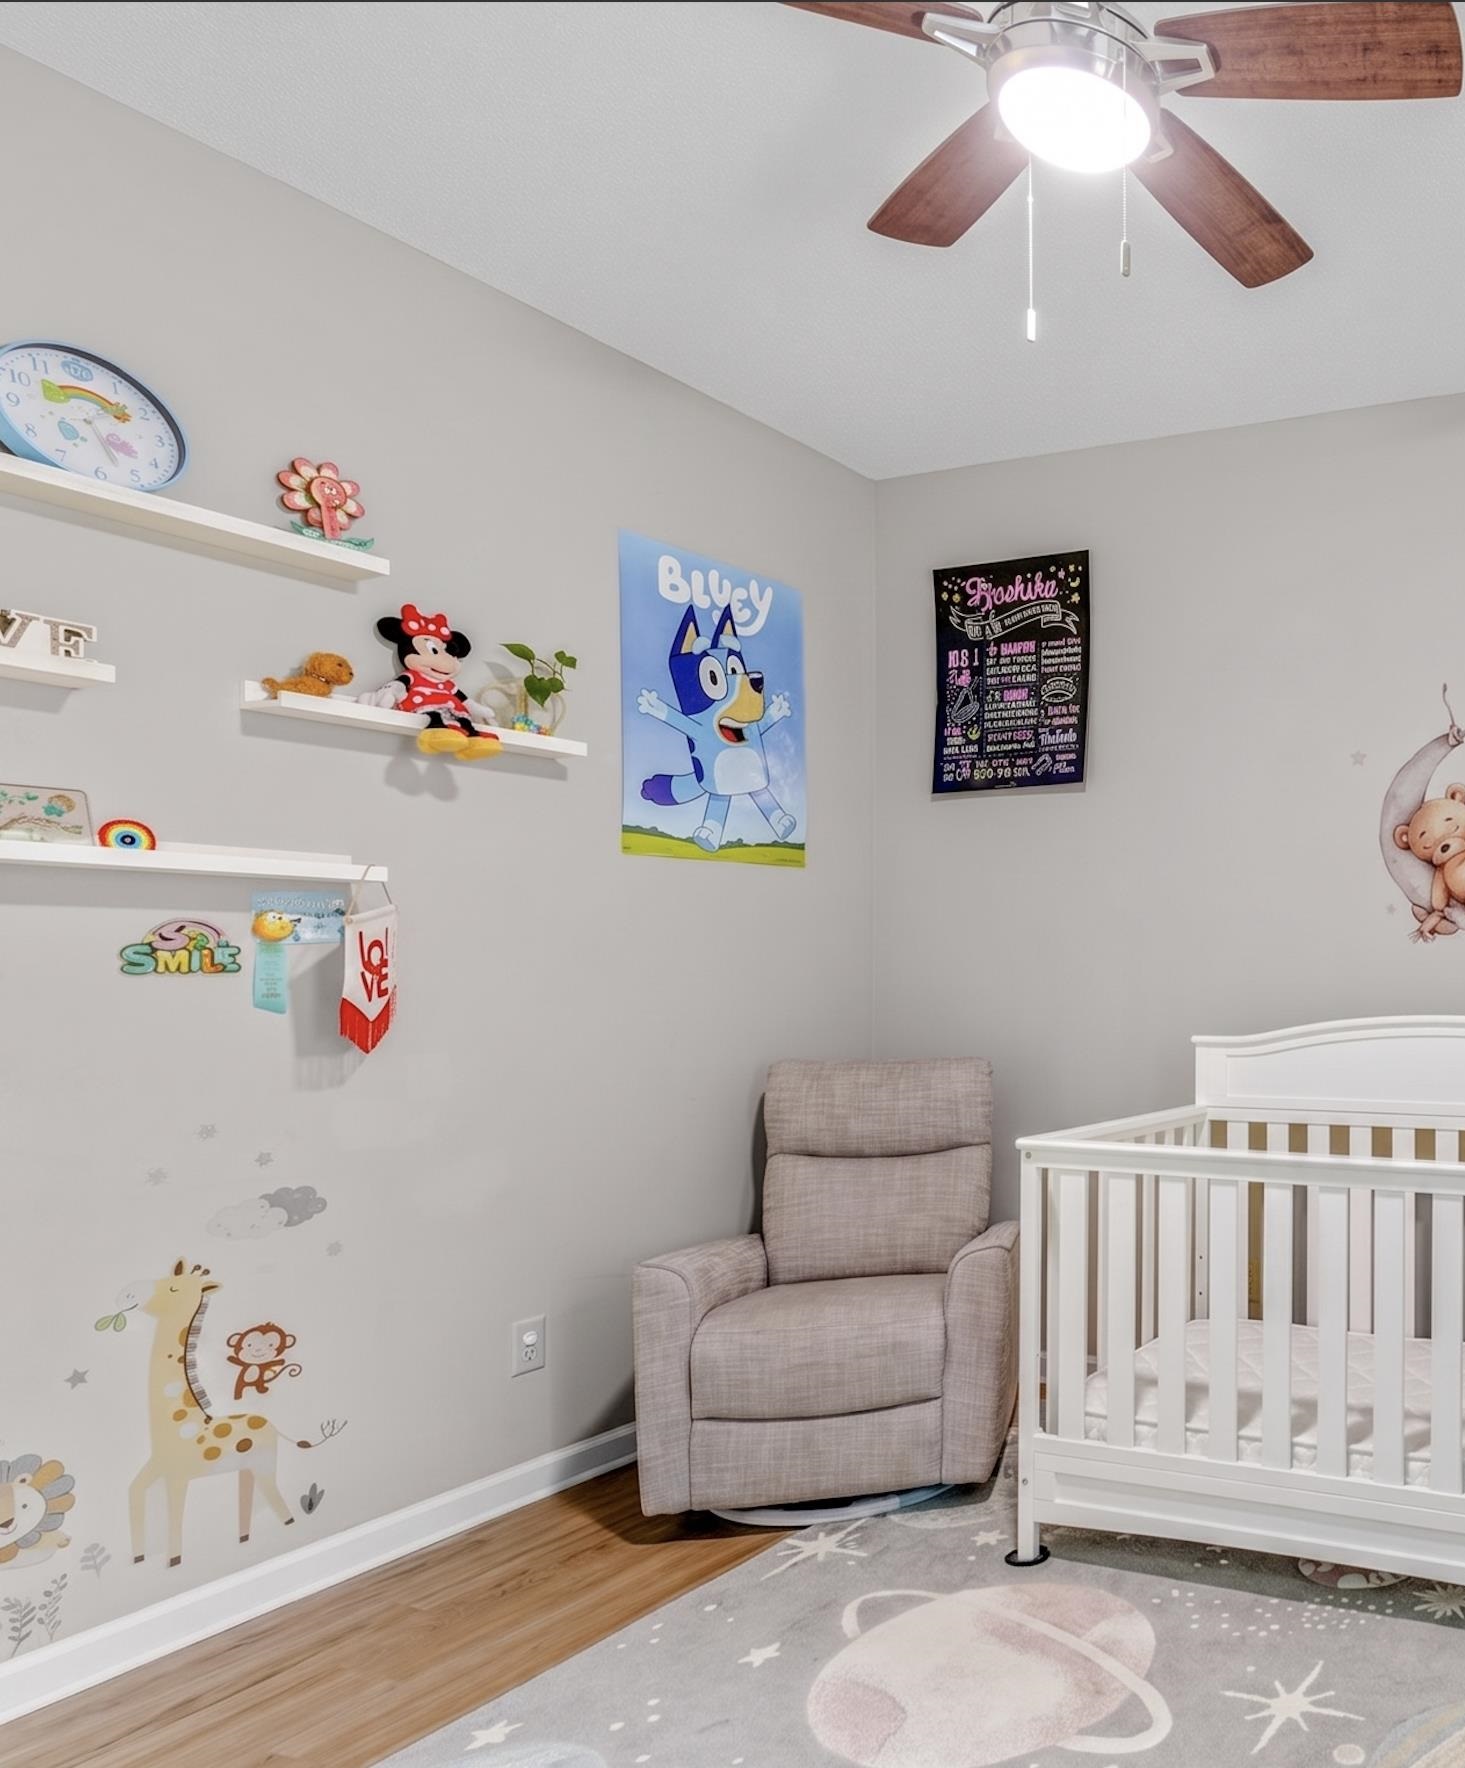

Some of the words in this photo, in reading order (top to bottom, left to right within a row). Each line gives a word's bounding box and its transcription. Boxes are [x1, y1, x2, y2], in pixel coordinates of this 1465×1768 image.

[5, 391, 21, 407] 9
[138, 407, 150, 421] 2
[154, 435, 166, 448] 3
[94, 466, 108, 481] 6
[129, 468, 142, 483] 5
[120, 938, 242, 975] SMILE
